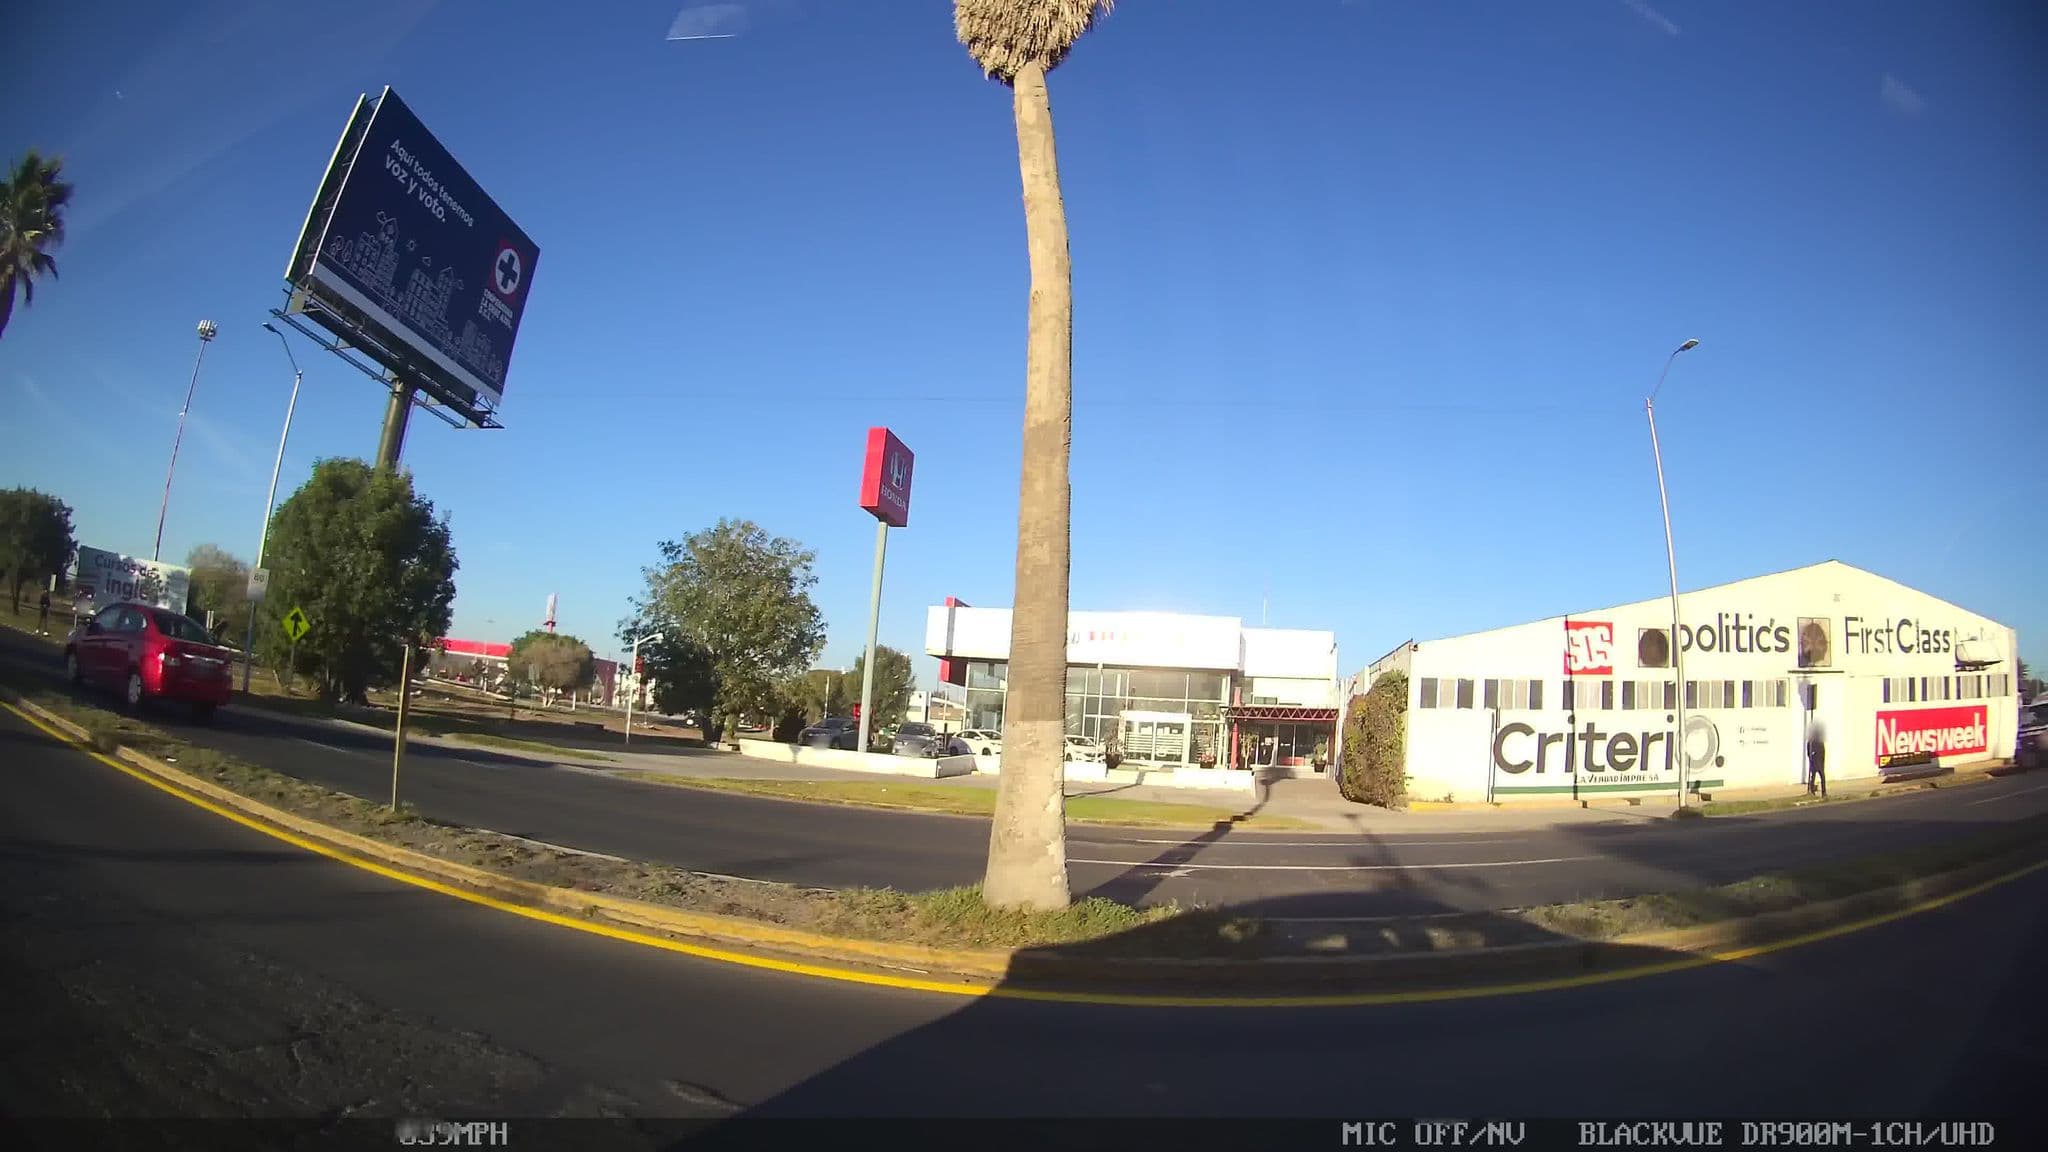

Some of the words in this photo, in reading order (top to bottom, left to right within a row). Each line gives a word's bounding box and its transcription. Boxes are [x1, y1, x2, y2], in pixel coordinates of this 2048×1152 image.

[385, 153, 408, 184] voz
[407, 177, 418, 194] y
[418, 186, 446, 222] voto.
[390, 139, 416, 167] Aquí
[413, 160, 439, 192] todos
[439, 185, 474, 227] tenemos
[880, 484, 908, 512] HONDA
[1877, 711, 1985, 756] Newsweek
